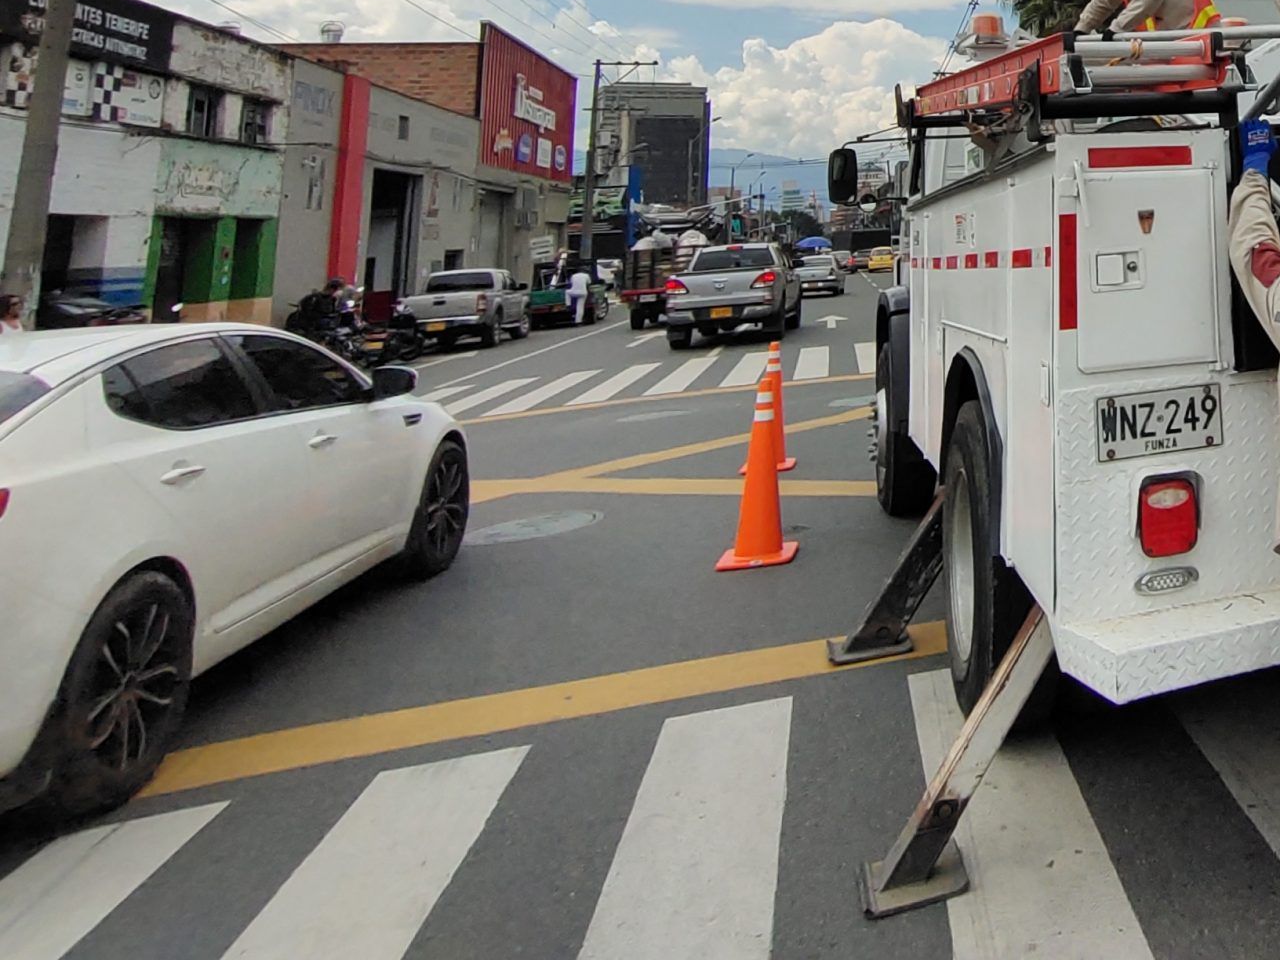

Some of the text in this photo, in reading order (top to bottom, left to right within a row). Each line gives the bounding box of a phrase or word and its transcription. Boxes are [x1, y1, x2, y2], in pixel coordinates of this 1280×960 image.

[105, 12, 150, 40] TENERIFE
[1164, 394, 1217, 435] 249
[1144, 438, 1178, 452] FUNZA
